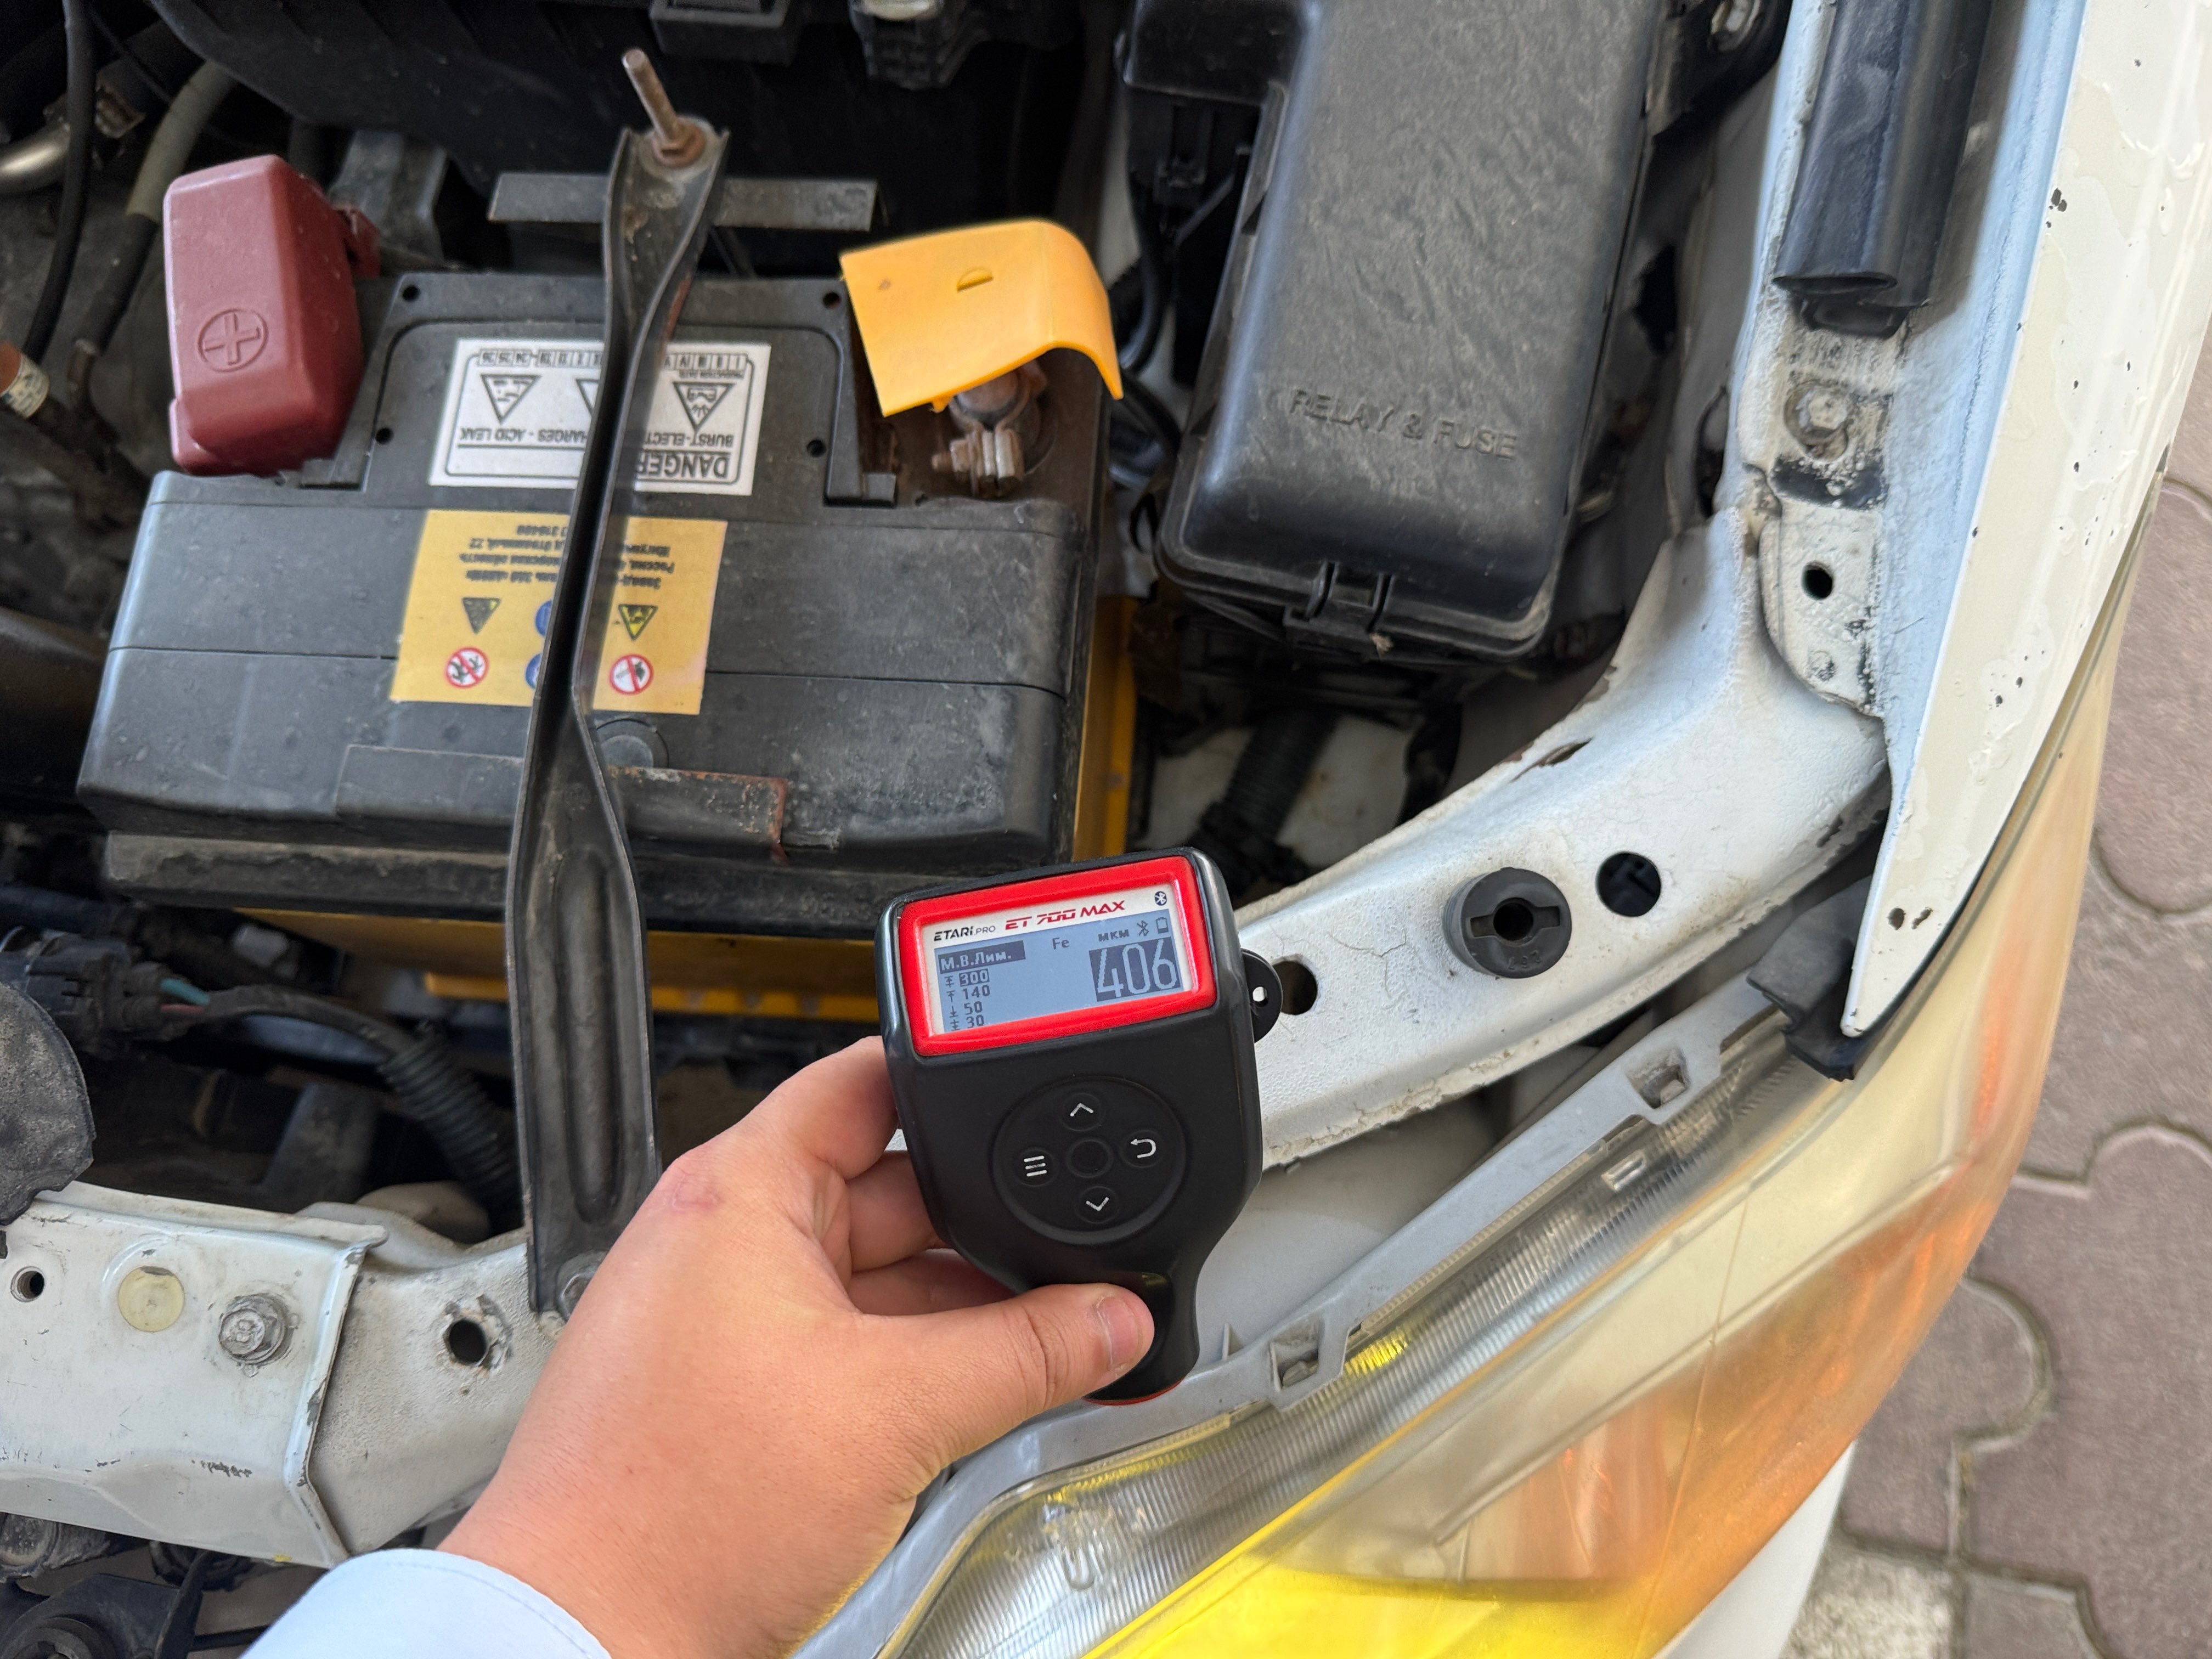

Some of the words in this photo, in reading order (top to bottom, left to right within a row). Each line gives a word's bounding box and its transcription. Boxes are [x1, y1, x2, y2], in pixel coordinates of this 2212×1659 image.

[1289, 389, 1395, 432] RELAY
[1401, 413, 1423, 440] &
[1432, 419, 1519, 460] FUSE
[460, 427, 492, 442] LEAK
[495, 428, 527, 442] ACID
[1006, 916, 1032, 930] ET
[1037, 909, 1076, 925] 700
[1080, 900, 1125, 918] MAX
[1052, 937, 1069, 950] Fe
[1097, 939, 1178, 997] 406
[960, 969, 989, 986] 300
[962, 985, 990, 1000] 140
[964, 1001, 983, 1015] 50
[966, 1014, 984, 1029] 30
